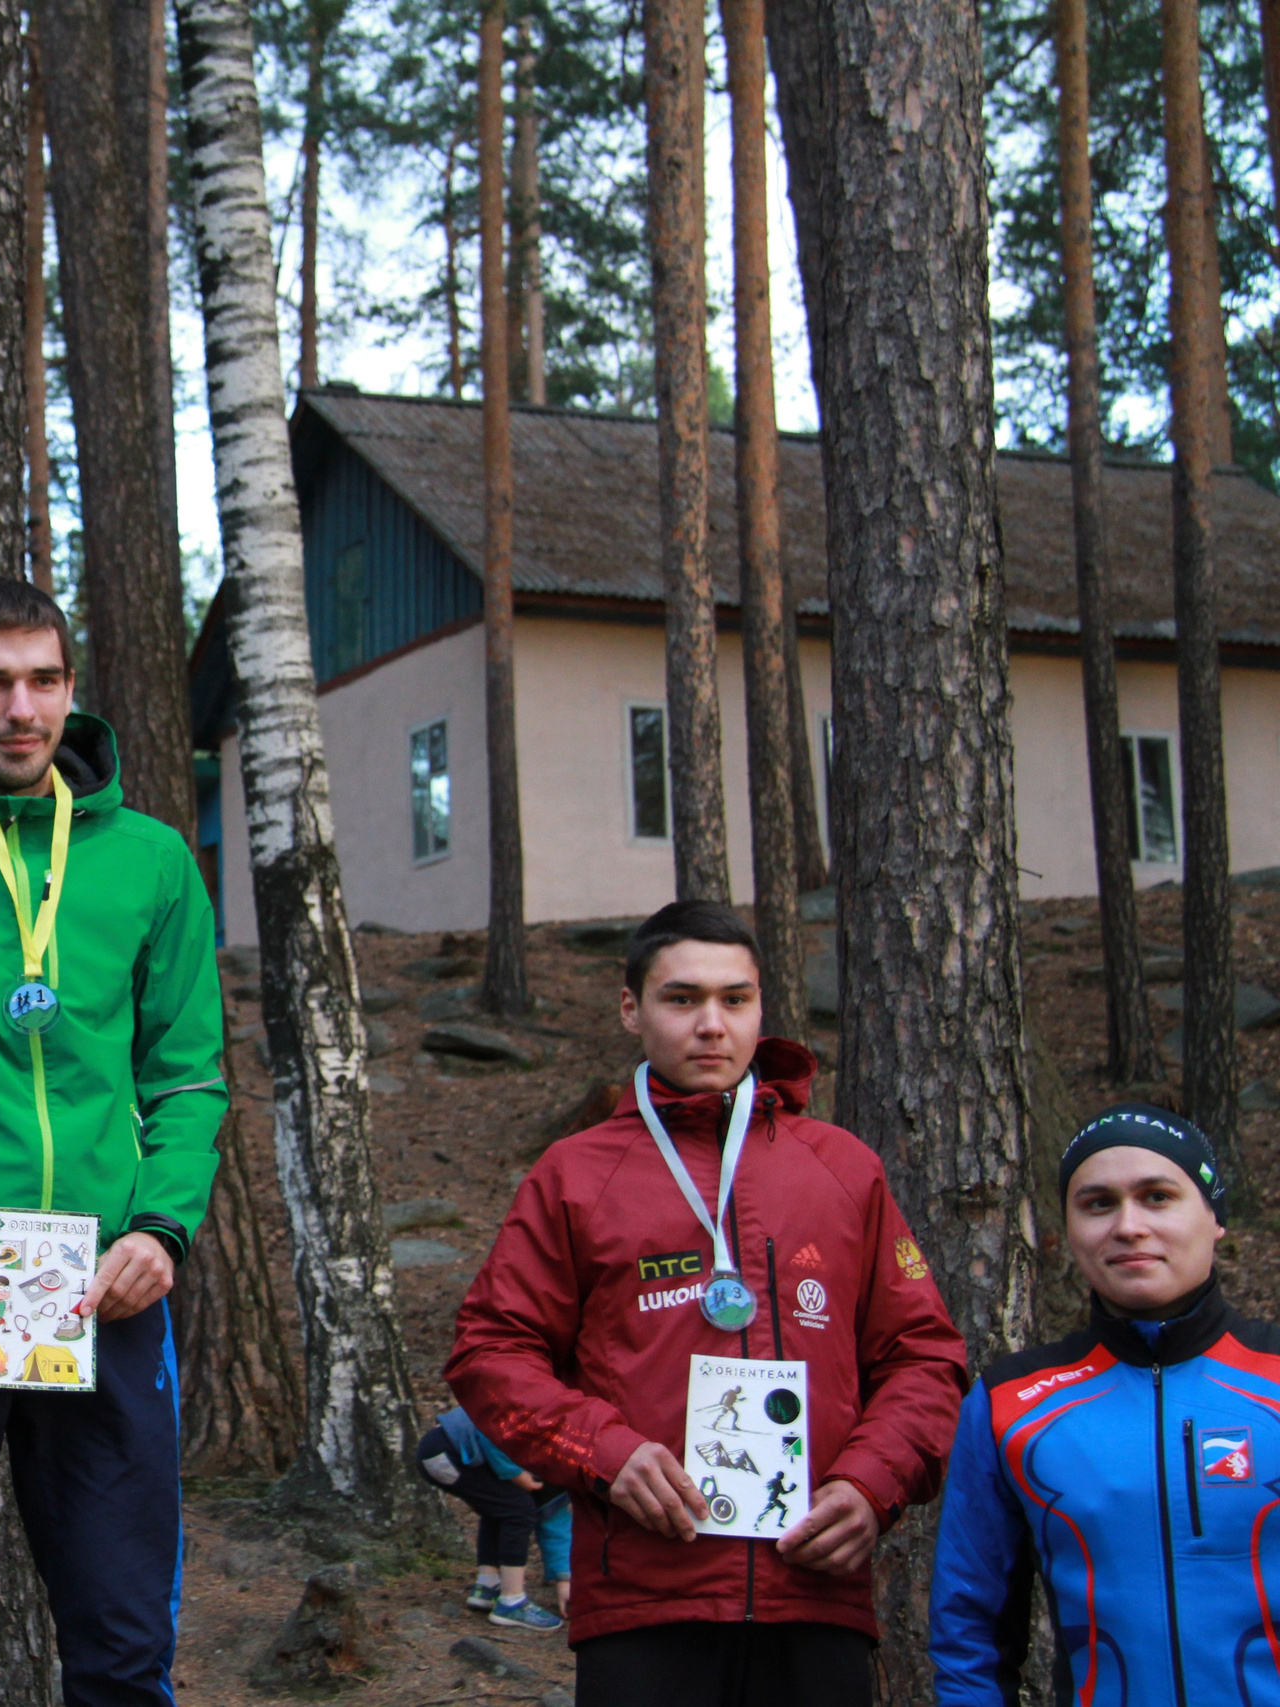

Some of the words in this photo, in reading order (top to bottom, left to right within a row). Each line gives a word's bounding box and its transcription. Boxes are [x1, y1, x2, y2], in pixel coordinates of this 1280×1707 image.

[36, 989, 46, 1003] 1
[7, 1219, 89, 1235] ORIENTEAM
[638, 1282, 706, 1312] LUKOIL
[732, 1286, 742, 1299] 3
[792, 1309, 830, 1322] Commercial
[799, 1319, 825, 1330] Vehicles
[715, 1366, 798, 1379] ORIENTEAM
